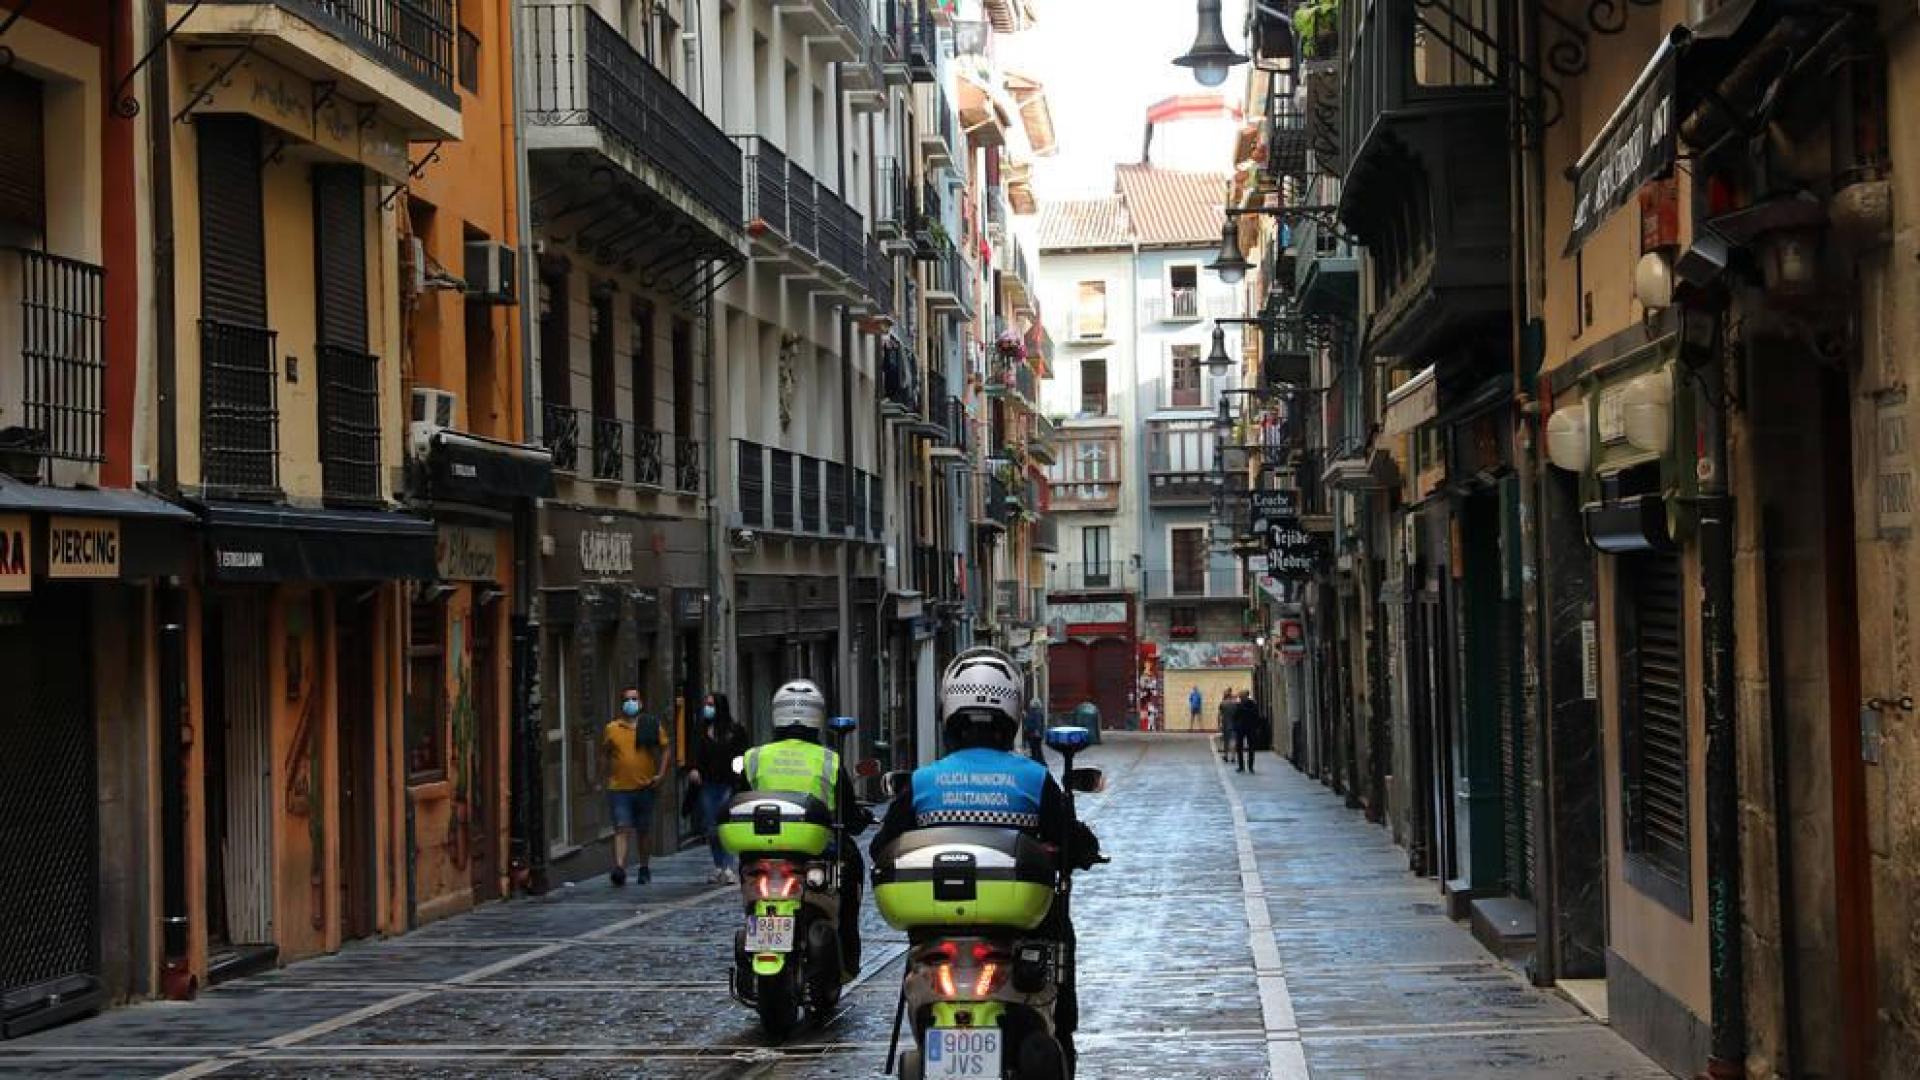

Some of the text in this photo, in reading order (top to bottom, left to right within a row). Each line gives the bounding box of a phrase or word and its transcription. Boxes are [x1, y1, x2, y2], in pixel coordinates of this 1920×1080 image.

[51, 527, 117, 566] PIERCING
[944, 1032, 996, 1054] 9006
[943, 1054, 984, 1075] JVS
